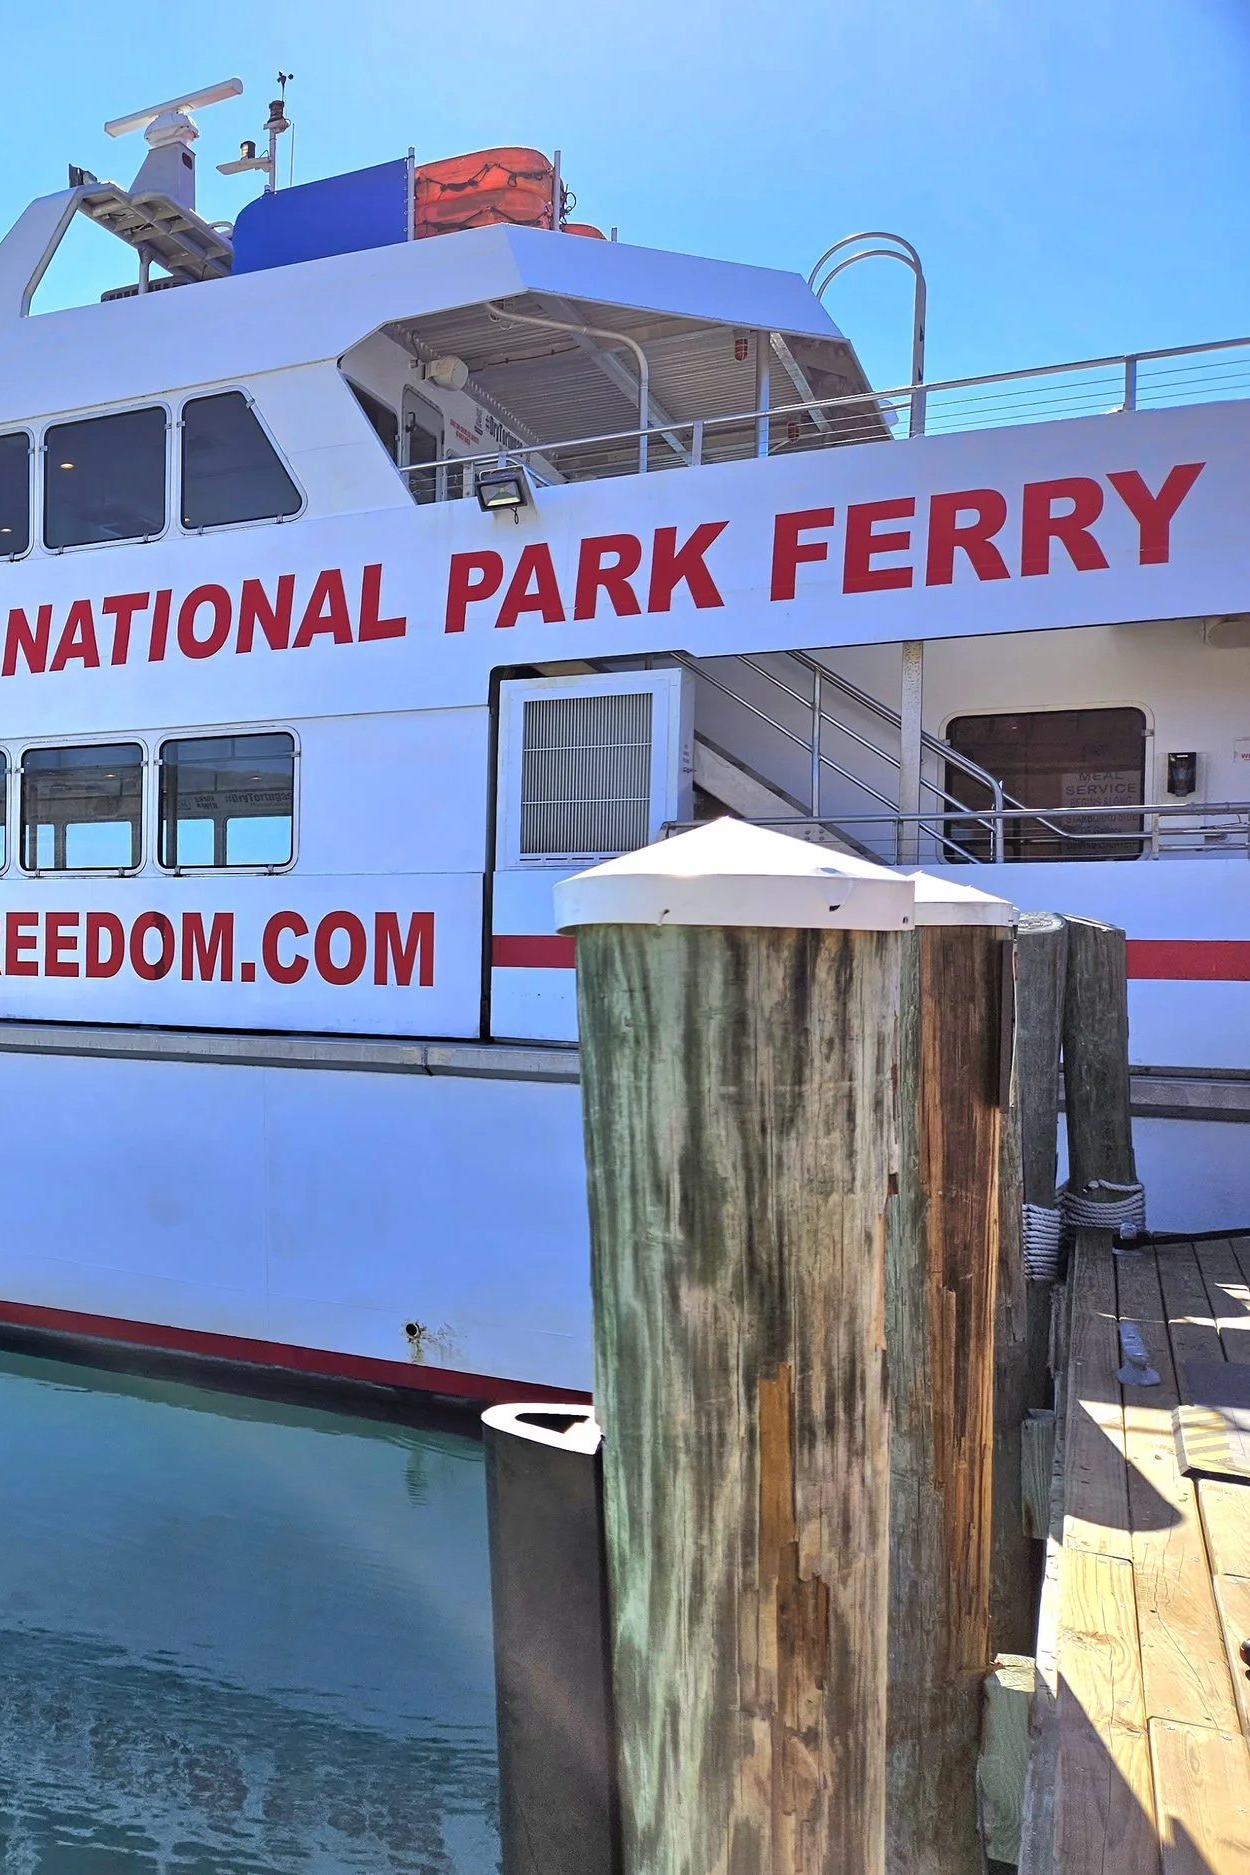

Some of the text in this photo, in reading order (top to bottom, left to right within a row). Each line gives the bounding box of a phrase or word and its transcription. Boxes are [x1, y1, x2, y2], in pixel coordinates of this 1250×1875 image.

[2, 564, 406, 676] NATIONAL
[445, 520, 729, 632] PARK
[771, 462, 1206, 600] FERRY
[1079, 772, 1124, 781] MEAL
[1065, 782, 1137, 796] SERVICE
